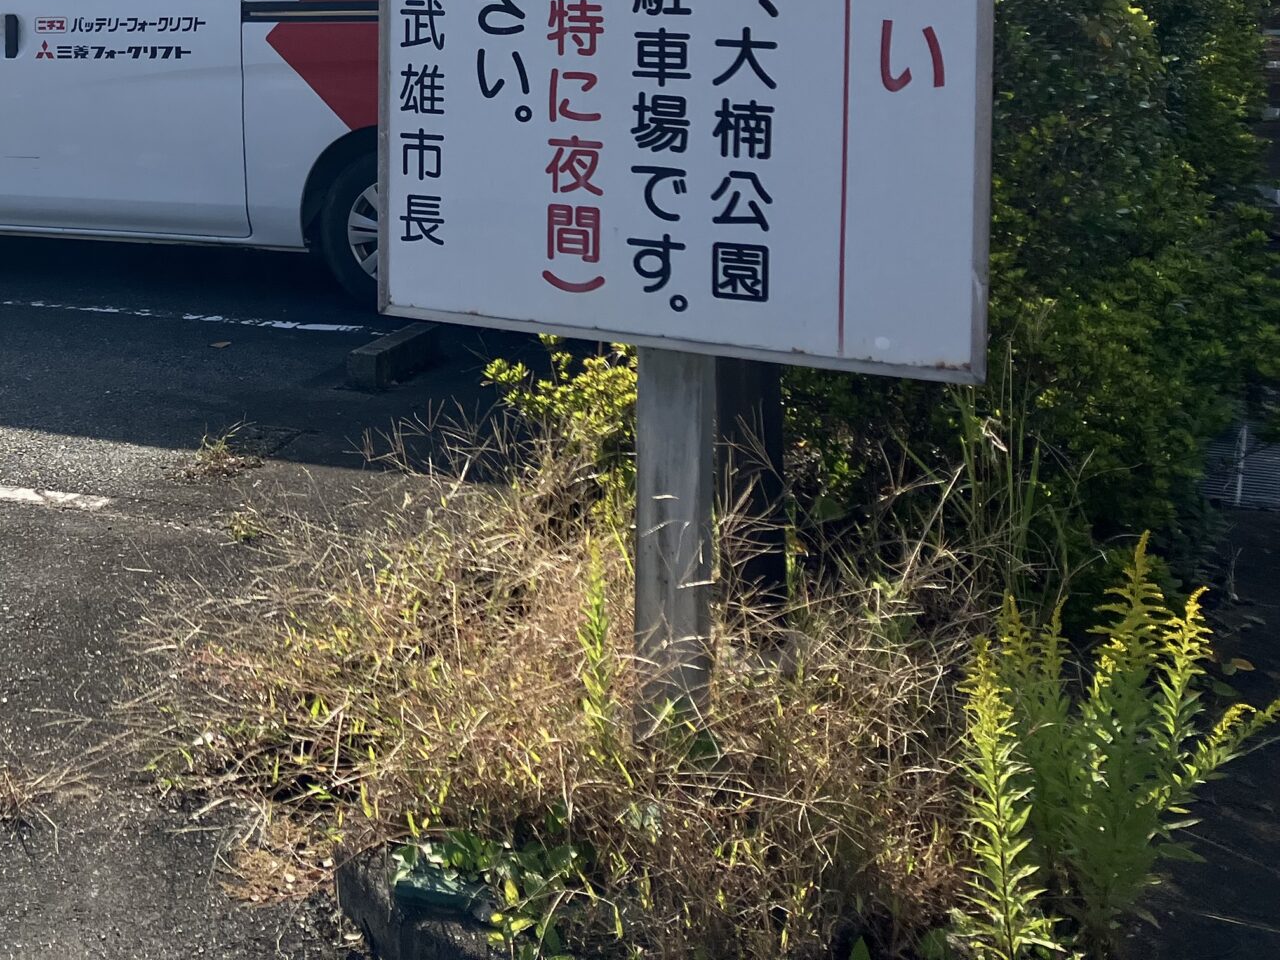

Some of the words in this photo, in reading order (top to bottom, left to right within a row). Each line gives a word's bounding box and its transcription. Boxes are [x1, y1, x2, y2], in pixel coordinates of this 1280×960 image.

[71, 17, 207, 33] バッテリーフォークリフト
[56, 45, 192, 60] 三菱フォークリフト
